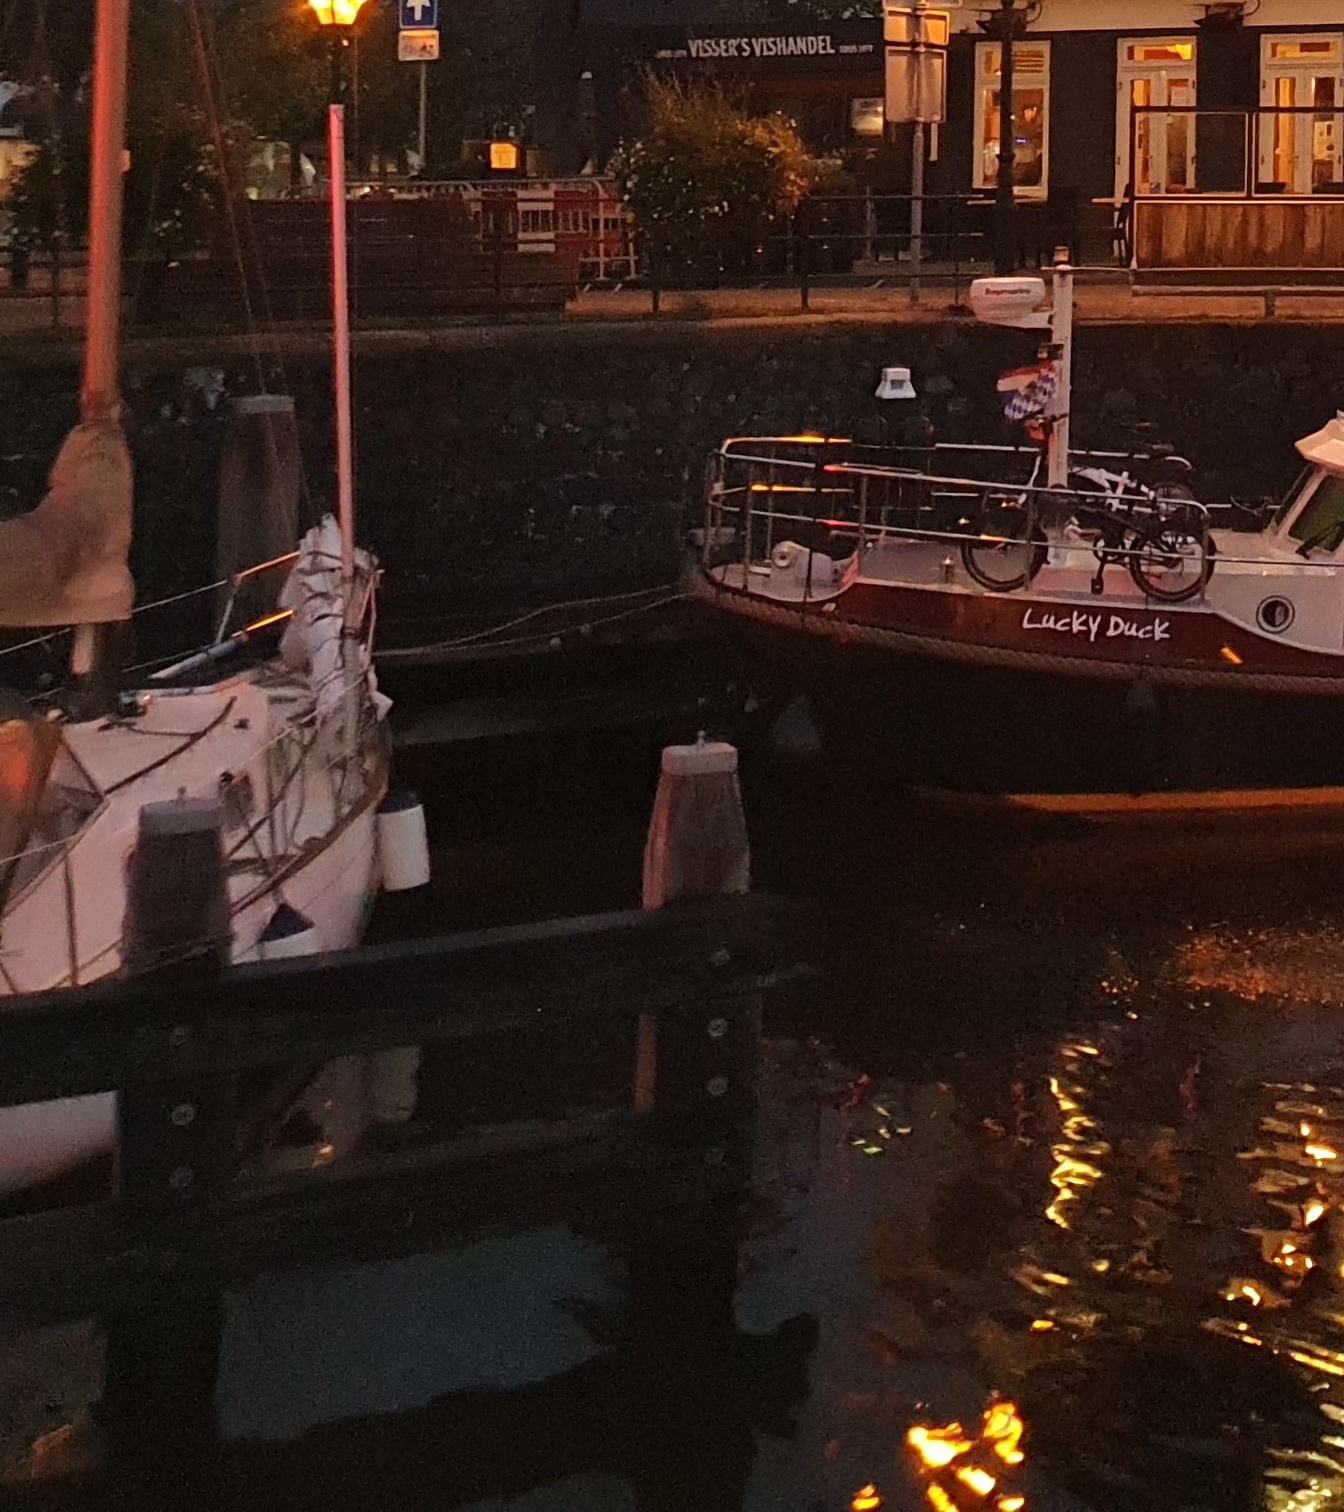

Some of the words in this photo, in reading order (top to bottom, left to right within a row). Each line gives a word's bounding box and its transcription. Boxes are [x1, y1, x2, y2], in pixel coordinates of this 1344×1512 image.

[688, 38, 751, 58] VISSER'S
[751, 35, 836, 57] VISHANDEL
[1022, 607, 1102, 642] Lucky
[1106, 615, 1171, 641] Duck
